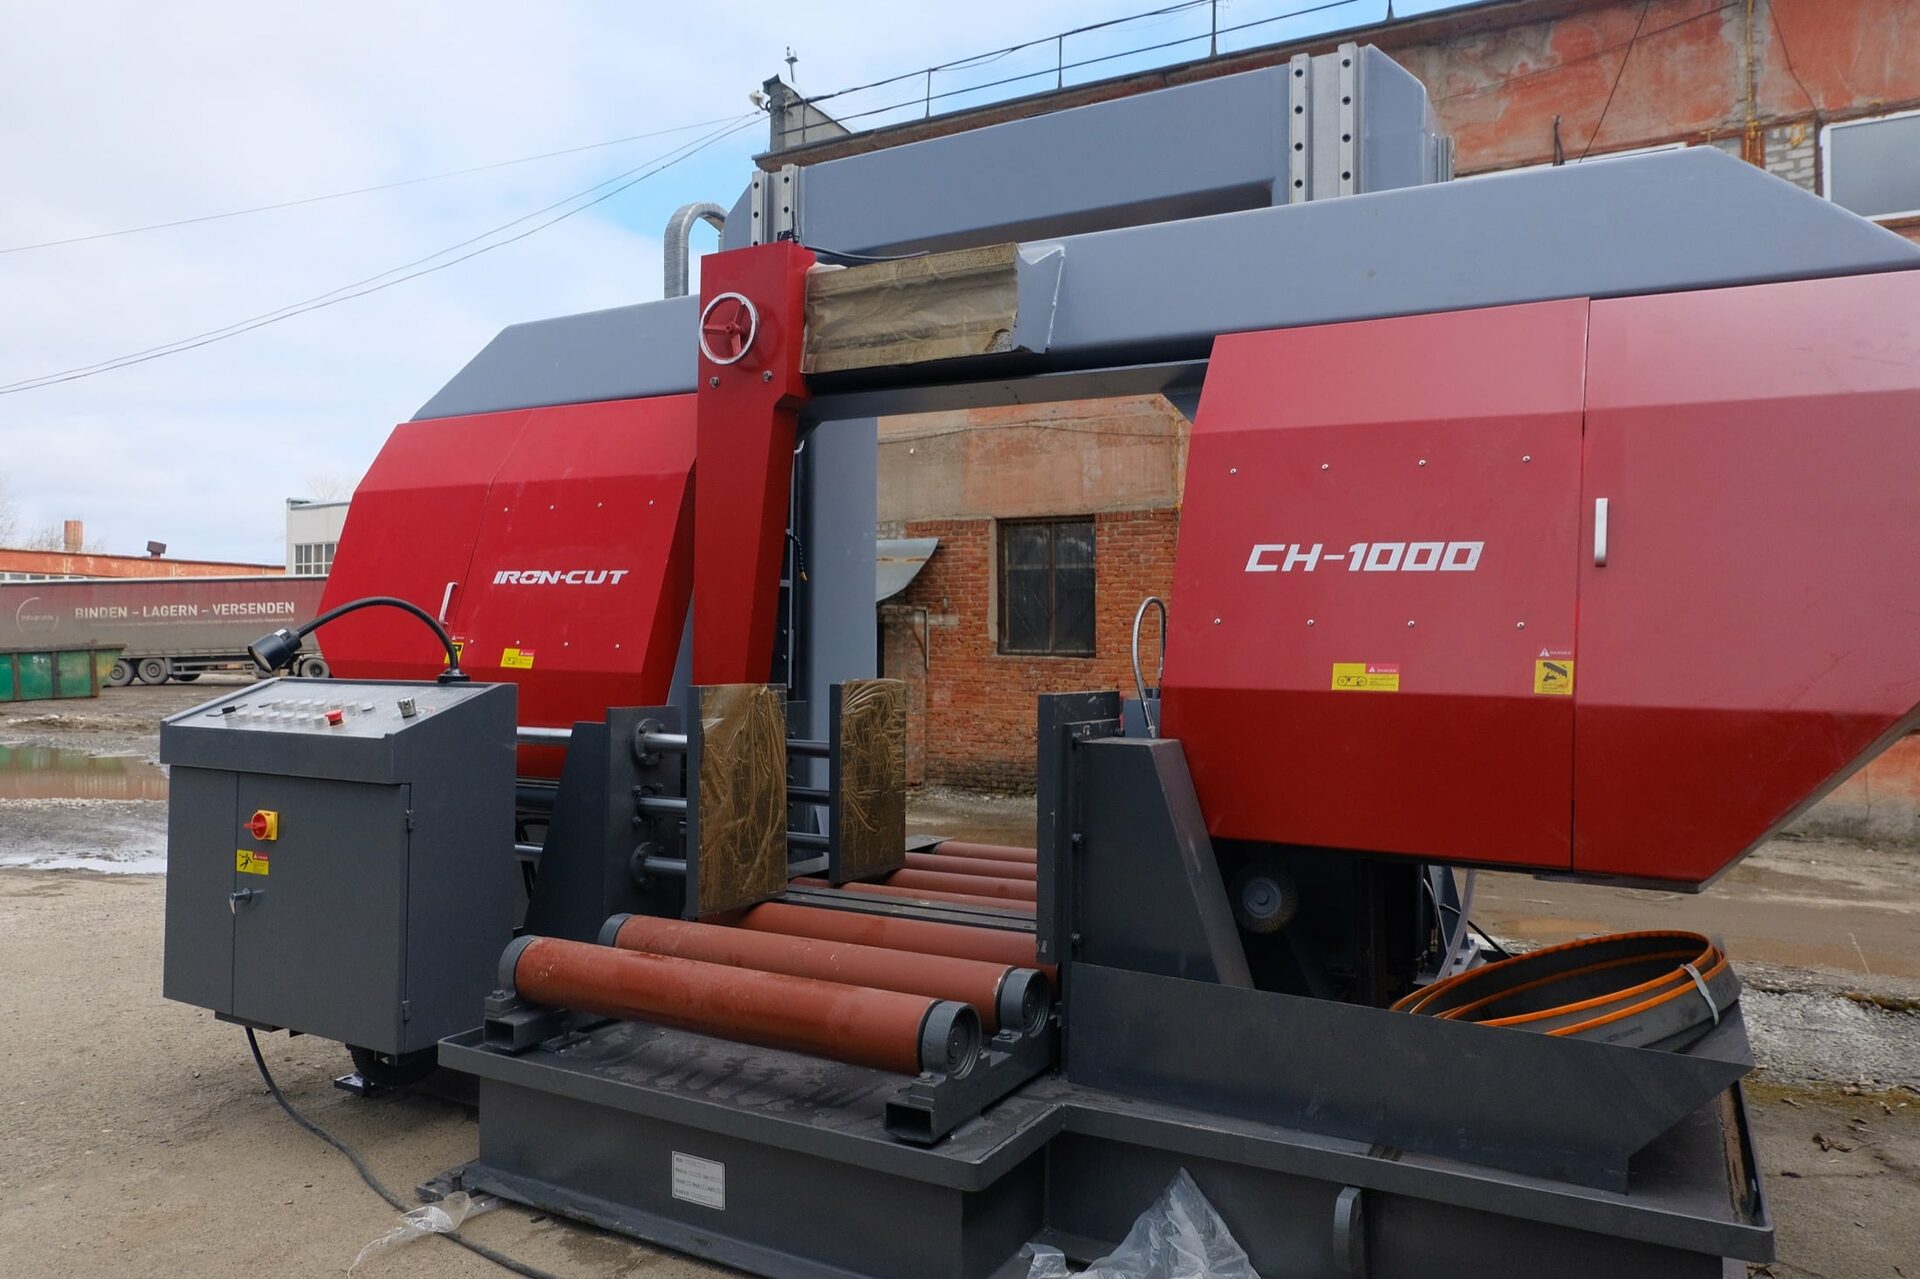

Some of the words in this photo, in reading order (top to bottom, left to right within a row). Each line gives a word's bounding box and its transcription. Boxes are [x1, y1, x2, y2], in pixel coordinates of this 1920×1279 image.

[1244, 541, 1485, 572] CH-1000
[75, 607, 127, 620] BINDEN
[143, 605, 197, 618] LAGERN
[213, 602, 294, 616] VERSENDEN
